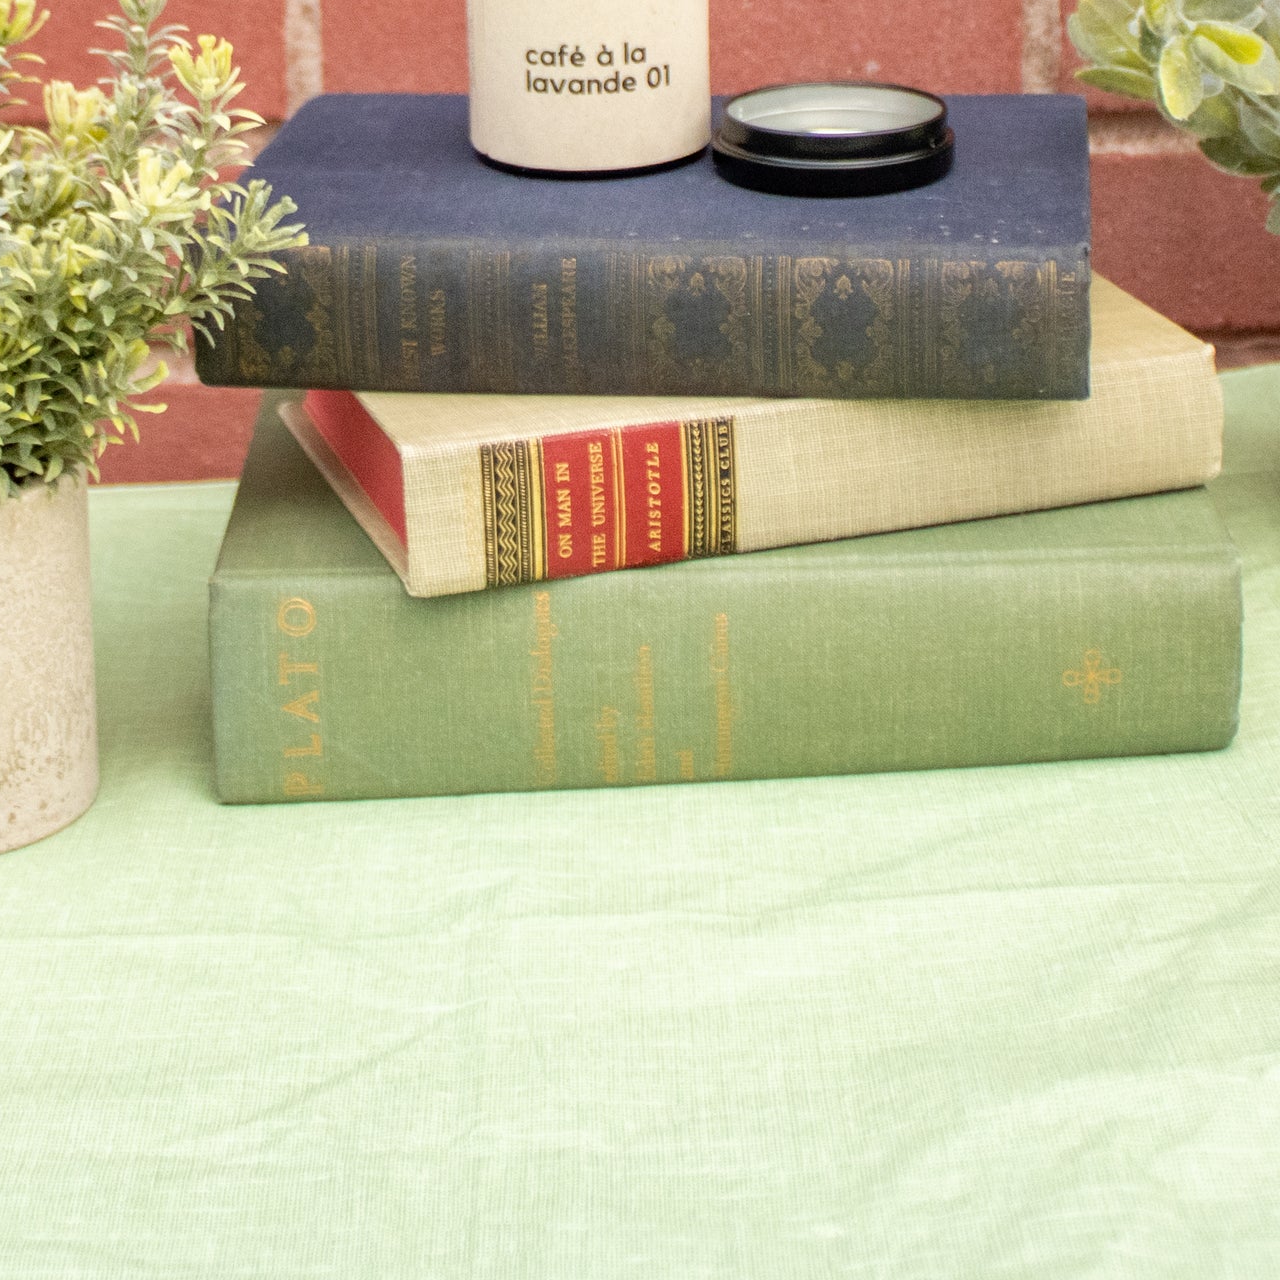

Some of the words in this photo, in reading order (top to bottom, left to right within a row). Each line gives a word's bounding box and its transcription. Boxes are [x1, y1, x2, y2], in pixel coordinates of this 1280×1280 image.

[525, 44, 586, 67] café
[596, 44, 613, 67] à
[624, 42, 646, 65] la
[525, 70, 637, 94] lavande
[646, 64, 670, 88] 01
[399, 255, 418, 329] KNOWN
[431, 288, 447, 357] WORKS
[719, 424, 730, 470] CLUB
[556, 462, 570, 482] IN
[589, 442, 606, 526] UNIVERSE
[556, 489, 572, 527] MAN
[646, 441, 662, 552] ARISTOTLE
[720, 477, 732, 554] CLASSICS
[558, 533, 573, 559] ON
[592, 533, 606, 567] THE
[277, 597, 323, 797] PLATO
